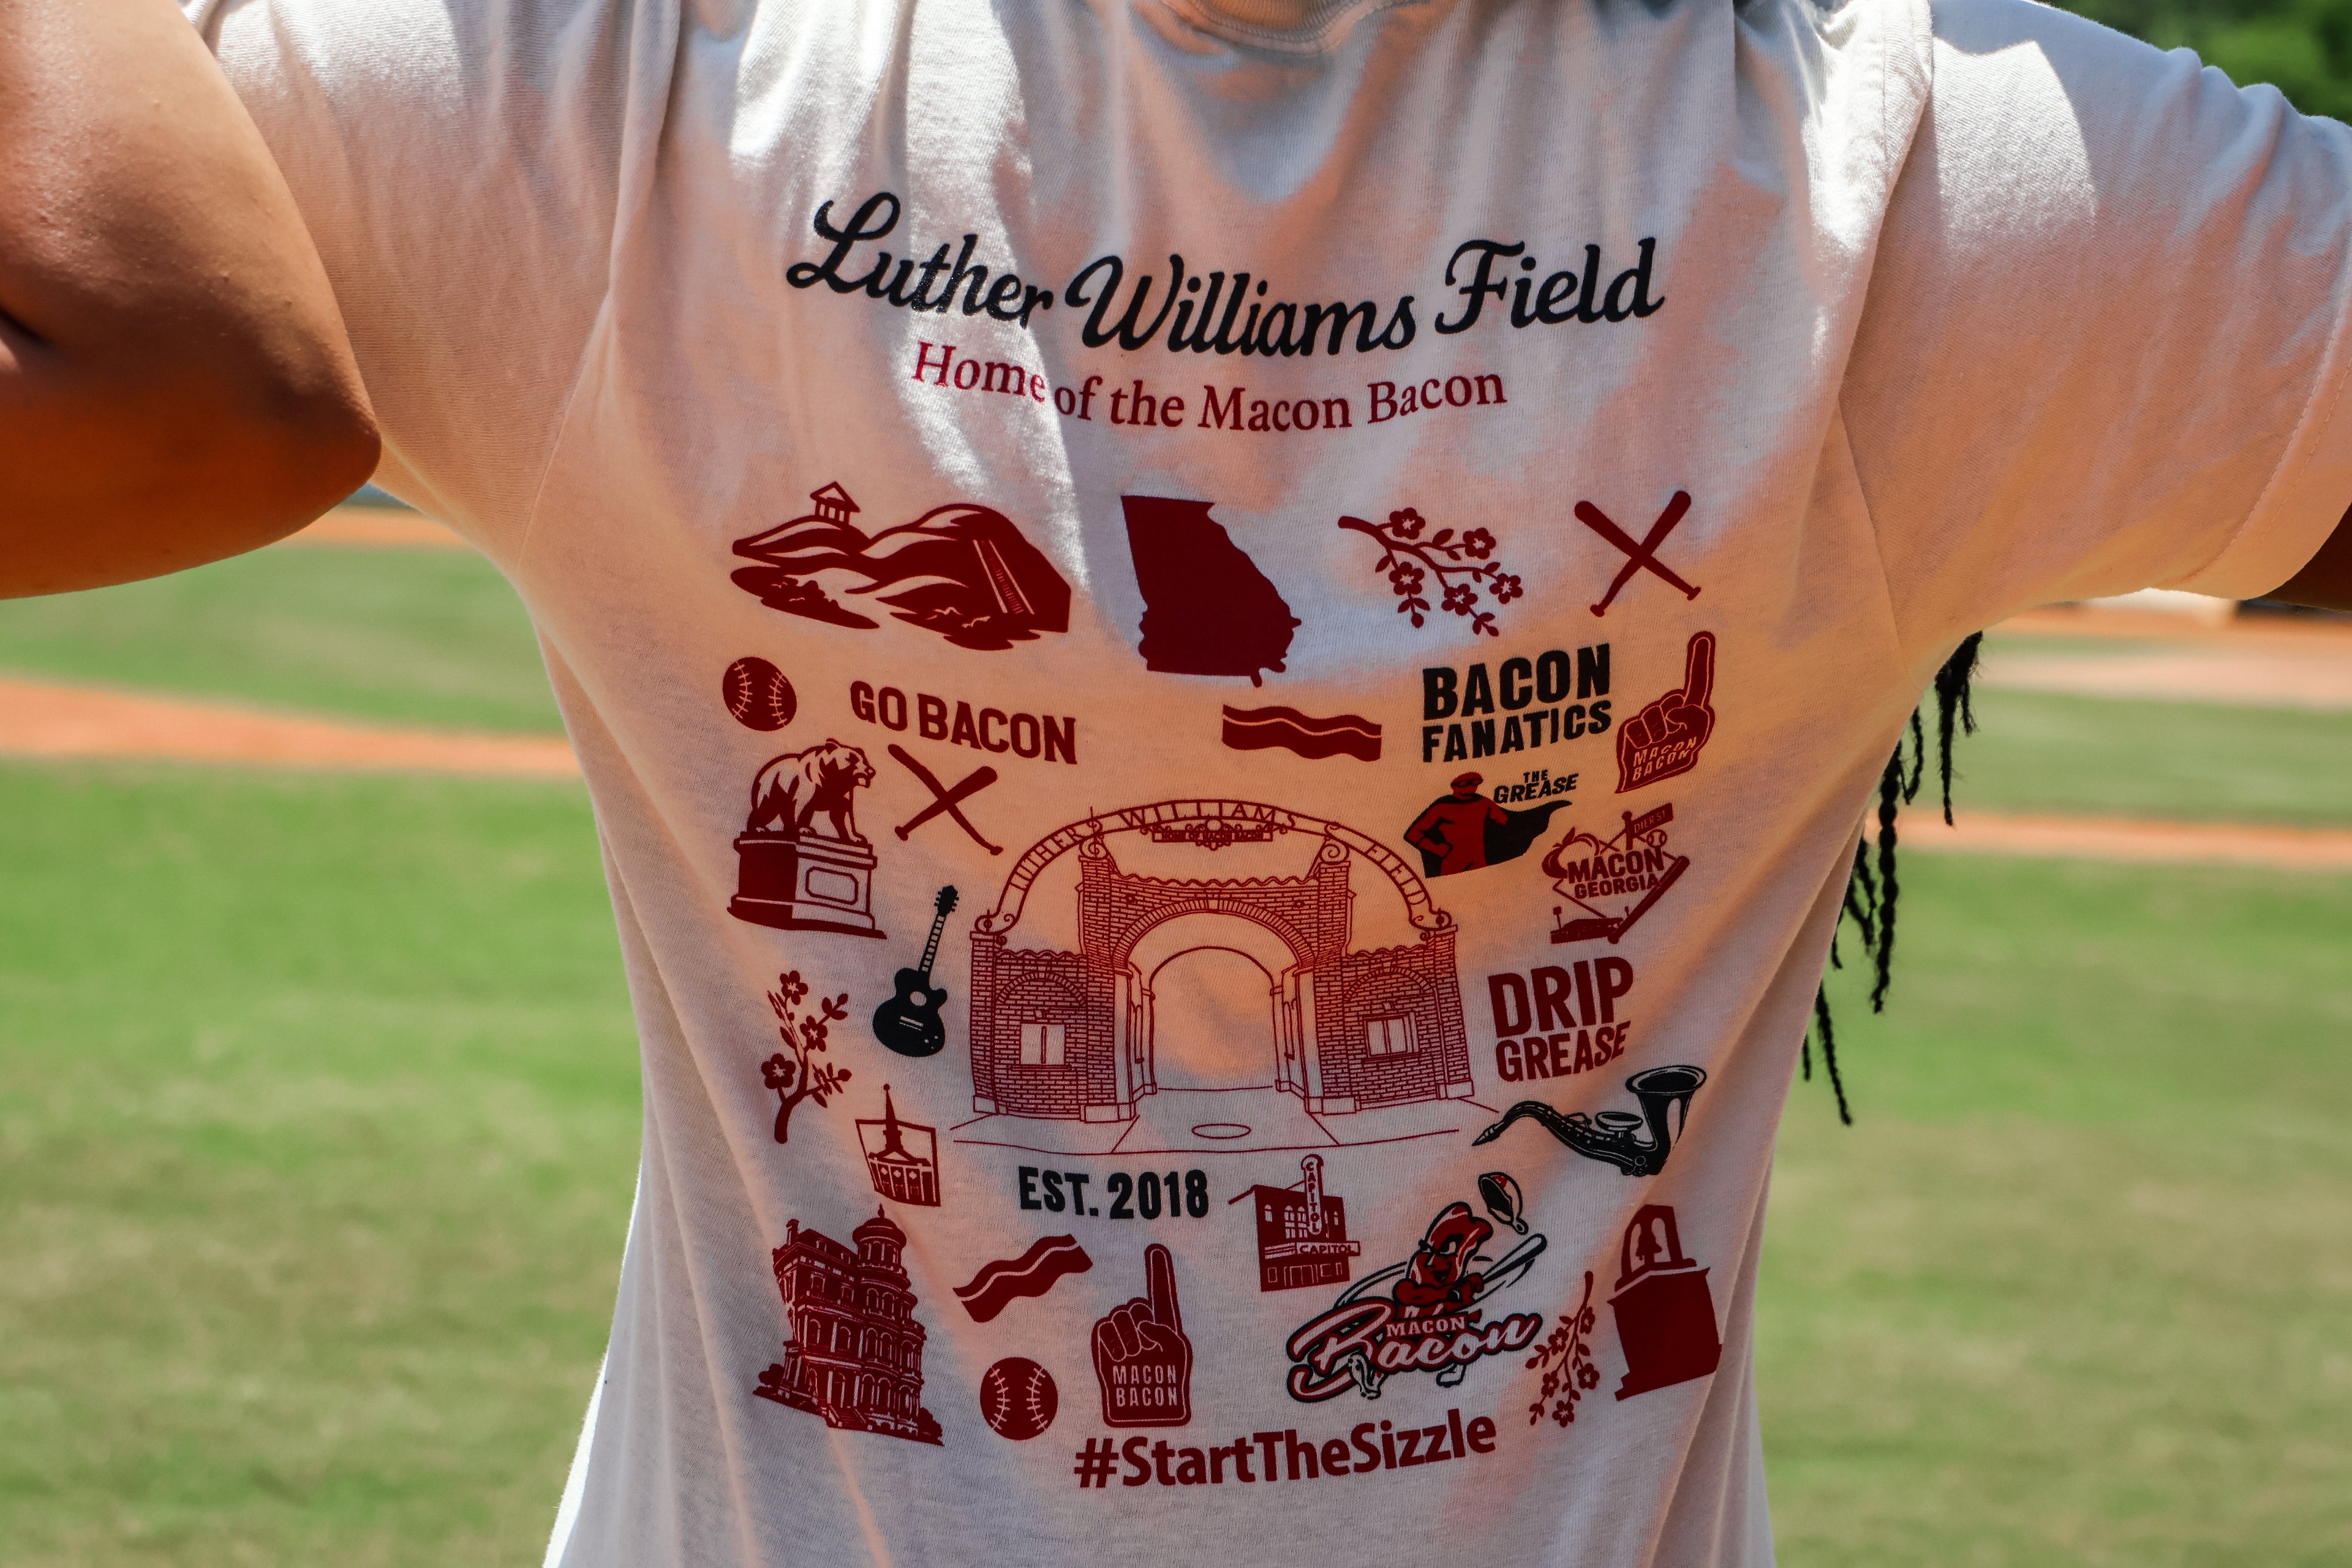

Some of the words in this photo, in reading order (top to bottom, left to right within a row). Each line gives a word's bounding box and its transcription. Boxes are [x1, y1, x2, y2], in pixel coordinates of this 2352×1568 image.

[786, 192, 1053, 329] Luther
[1065, 253, 1416, 356] Williams
[1434, 236, 1665, 334] Field
[911, 341, 1046, 402] Home
[1054, 375, 1104, 421] of
[1109, 380, 1185, 428] the
[1197, 385, 1352, 431] Macon
[1366, 372, 1507, 425] Bacon
[1422, 643, 1610, 720] BACON
[850, 680, 908, 731] GO
[918, 693, 1077, 765] BACON
[1422, 699, 1611, 763] FANATICS
[1523, 769, 1548, 783] THE
[1632, 749, 1690, 781] BACON
[1634, 736, 1697, 767] MACON
[1493, 773, 1579, 804] GREASE
[1567, 846, 1664, 883] MACON
[1574, 873, 1662, 899] GEORGIA
[1488, 956, 1634, 1038] DRIP
[1495, 1020, 1630, 1082] GREASE
[1019, 1166, 1099, 1216] EST.
[1107, 1169, 1209, 1219] 2018
[1306, 1162, 1319, 1232] CAPITOL
[1286, 1297, 1543, 1403] Bacon
[1386, 1316, 1466, 1337] MACON
[1112, 1365, 1177, 1384] MACON
[1115, 1387, 1178, 1407] BACON
[1074, 1409, 1496, 1488] #StartTheSizzle
